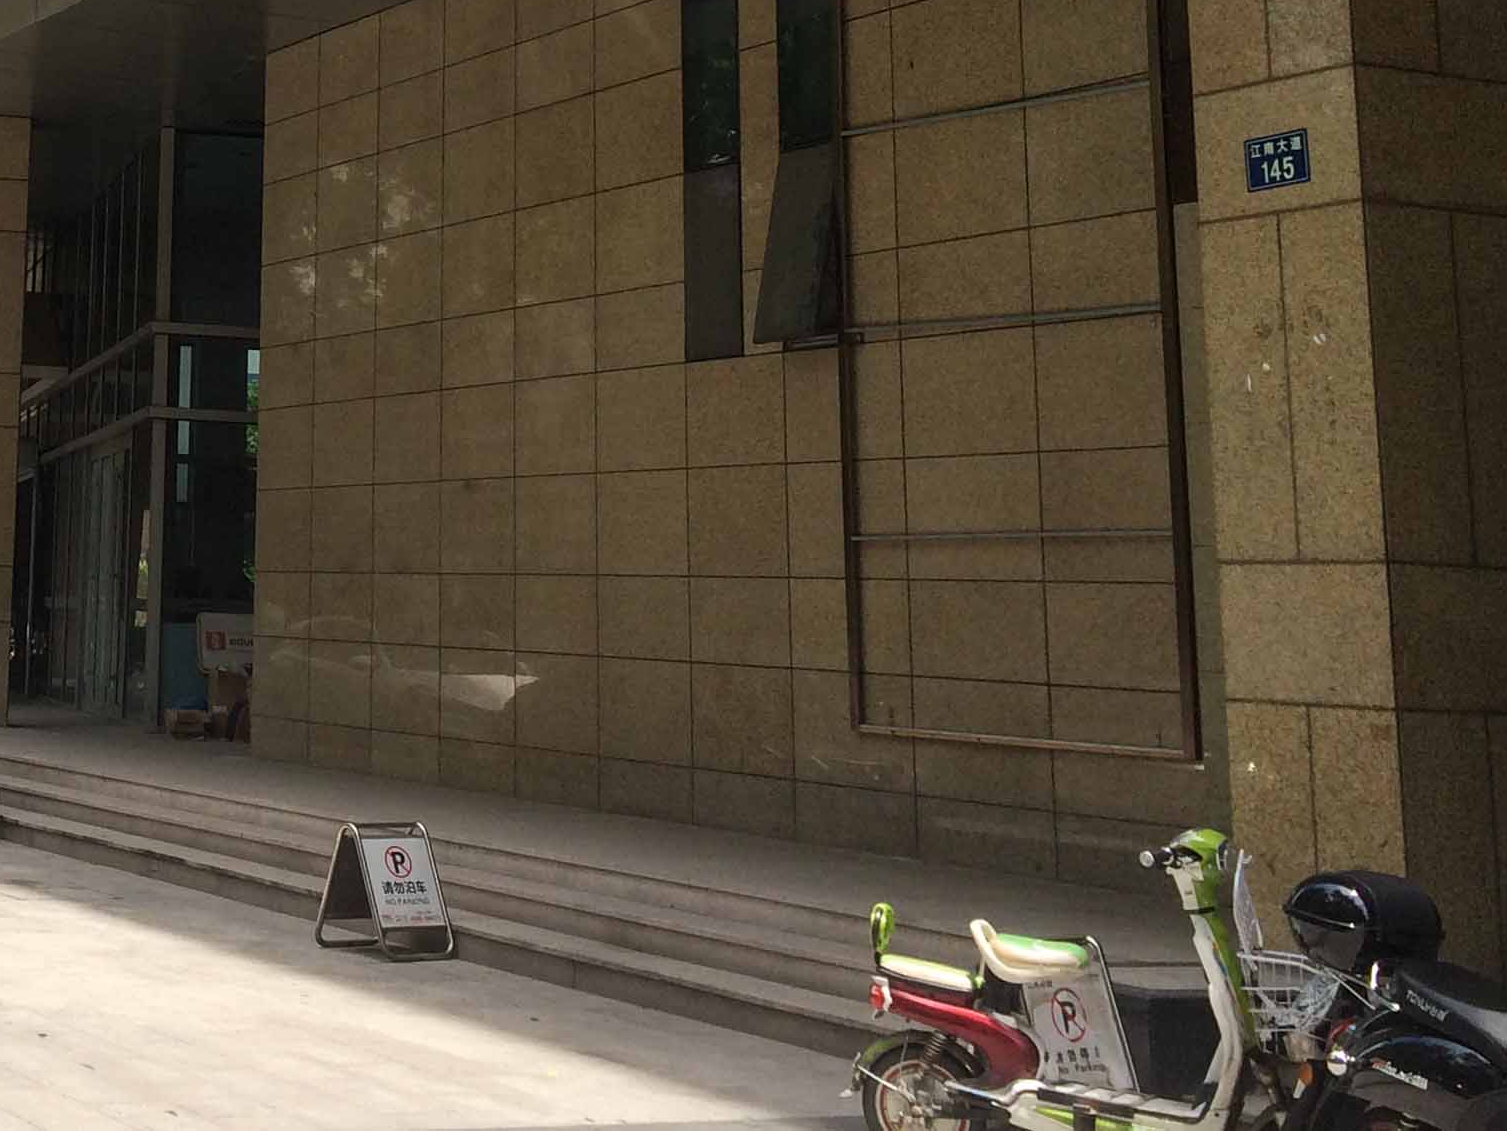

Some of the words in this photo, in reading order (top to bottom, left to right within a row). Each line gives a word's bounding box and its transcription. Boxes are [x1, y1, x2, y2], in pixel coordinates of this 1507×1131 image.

[1250, 135, 1303, 159] 江南大道
[1260, 155, 1295, 184] 145
[381, 880, 428, 896] 请勿泊车
